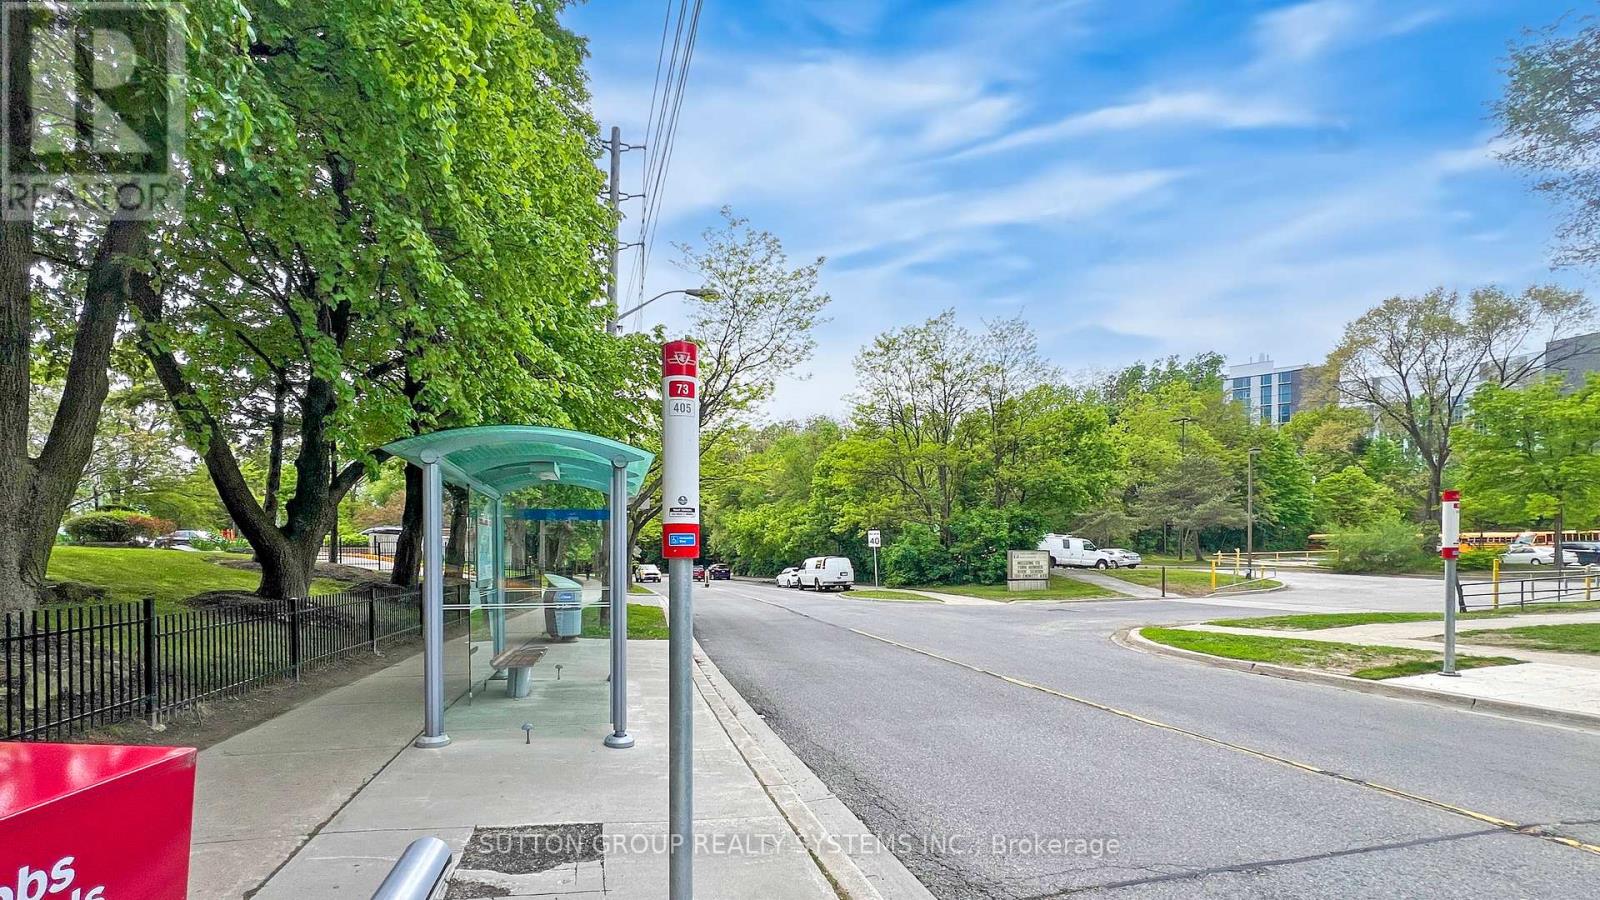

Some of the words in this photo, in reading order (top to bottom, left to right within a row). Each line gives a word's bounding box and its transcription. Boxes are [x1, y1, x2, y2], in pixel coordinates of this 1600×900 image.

[676, 383, 689, 395] 73
[673, 402, 692, 413] 405
[870, 537, 880, 545] 40
